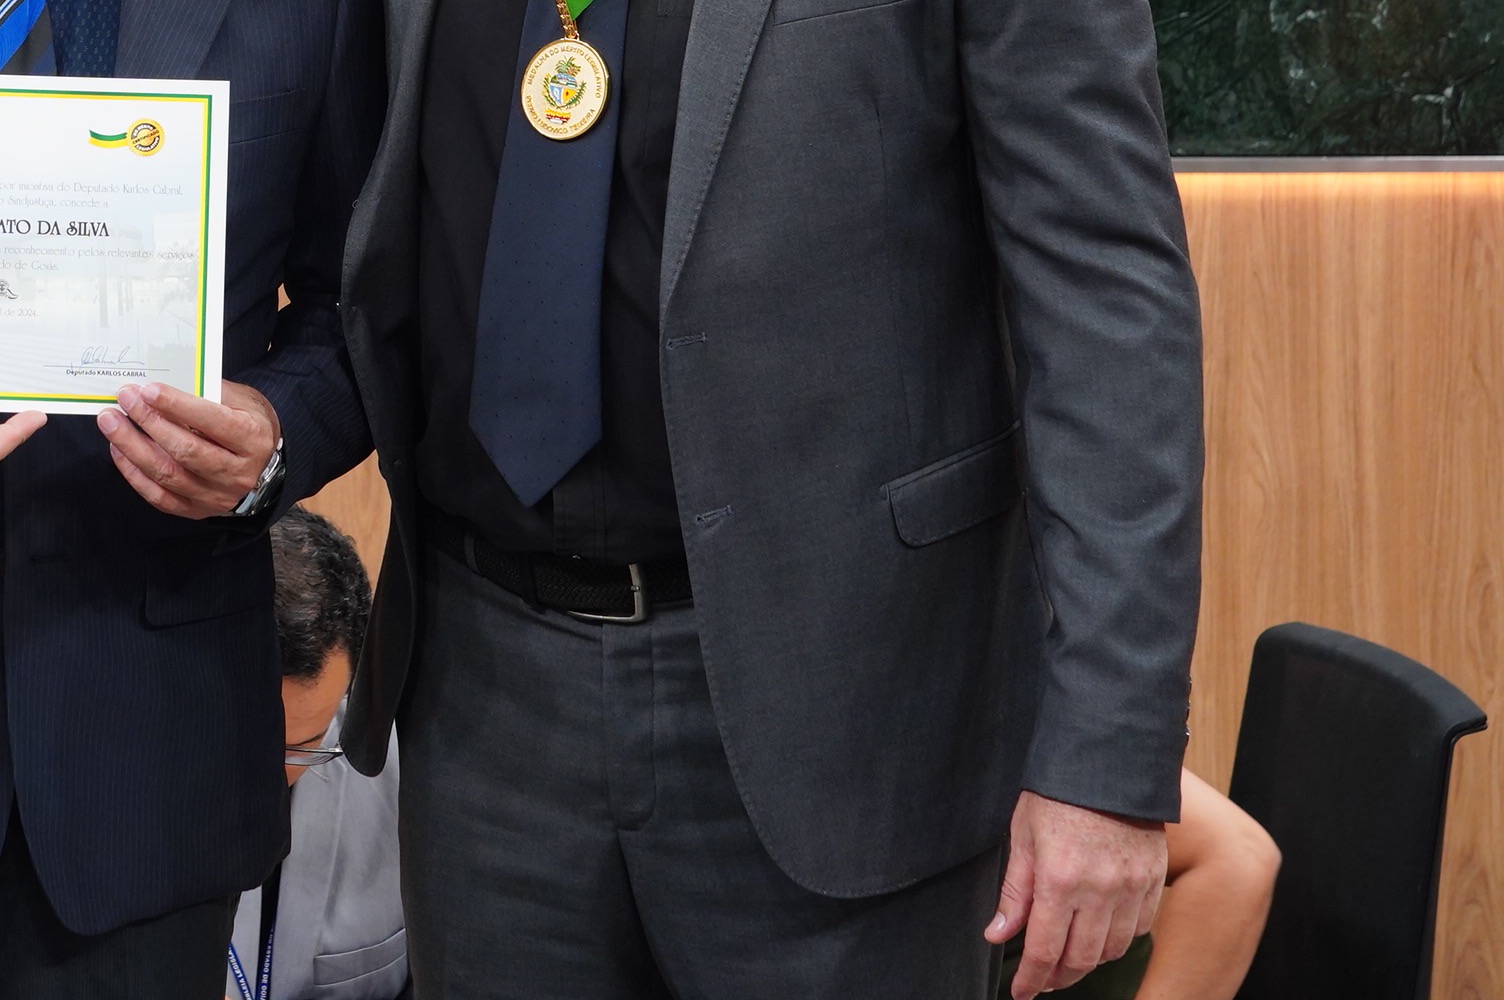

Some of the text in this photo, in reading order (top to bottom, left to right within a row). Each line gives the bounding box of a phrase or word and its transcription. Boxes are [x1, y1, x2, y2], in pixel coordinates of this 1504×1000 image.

[527, 53, 549, 85] MEDALHA
[550, 47, 560, 57] DO
[569, 108, 597, 132] TEIXEIRA
[56, 182, 71, 192] do
[73, 182, 120, 195] Deputado
[122, 183, 149, 194] Karlos
[59, 197, 100, 208] concede
[37, 220, 61, 236] DA
[66, 221, 110, 237] SILVA
[4, 245, 75, 257] reconhecimento
[78, 247, 105, 259] pelos
[107, 247, 154, 259] relevantes
[14, 259, 28, 270] de
[4, 307, 16, 316] de
[66, 369, 96, 377] Deputado
[261, 974, 268, 984] DE
